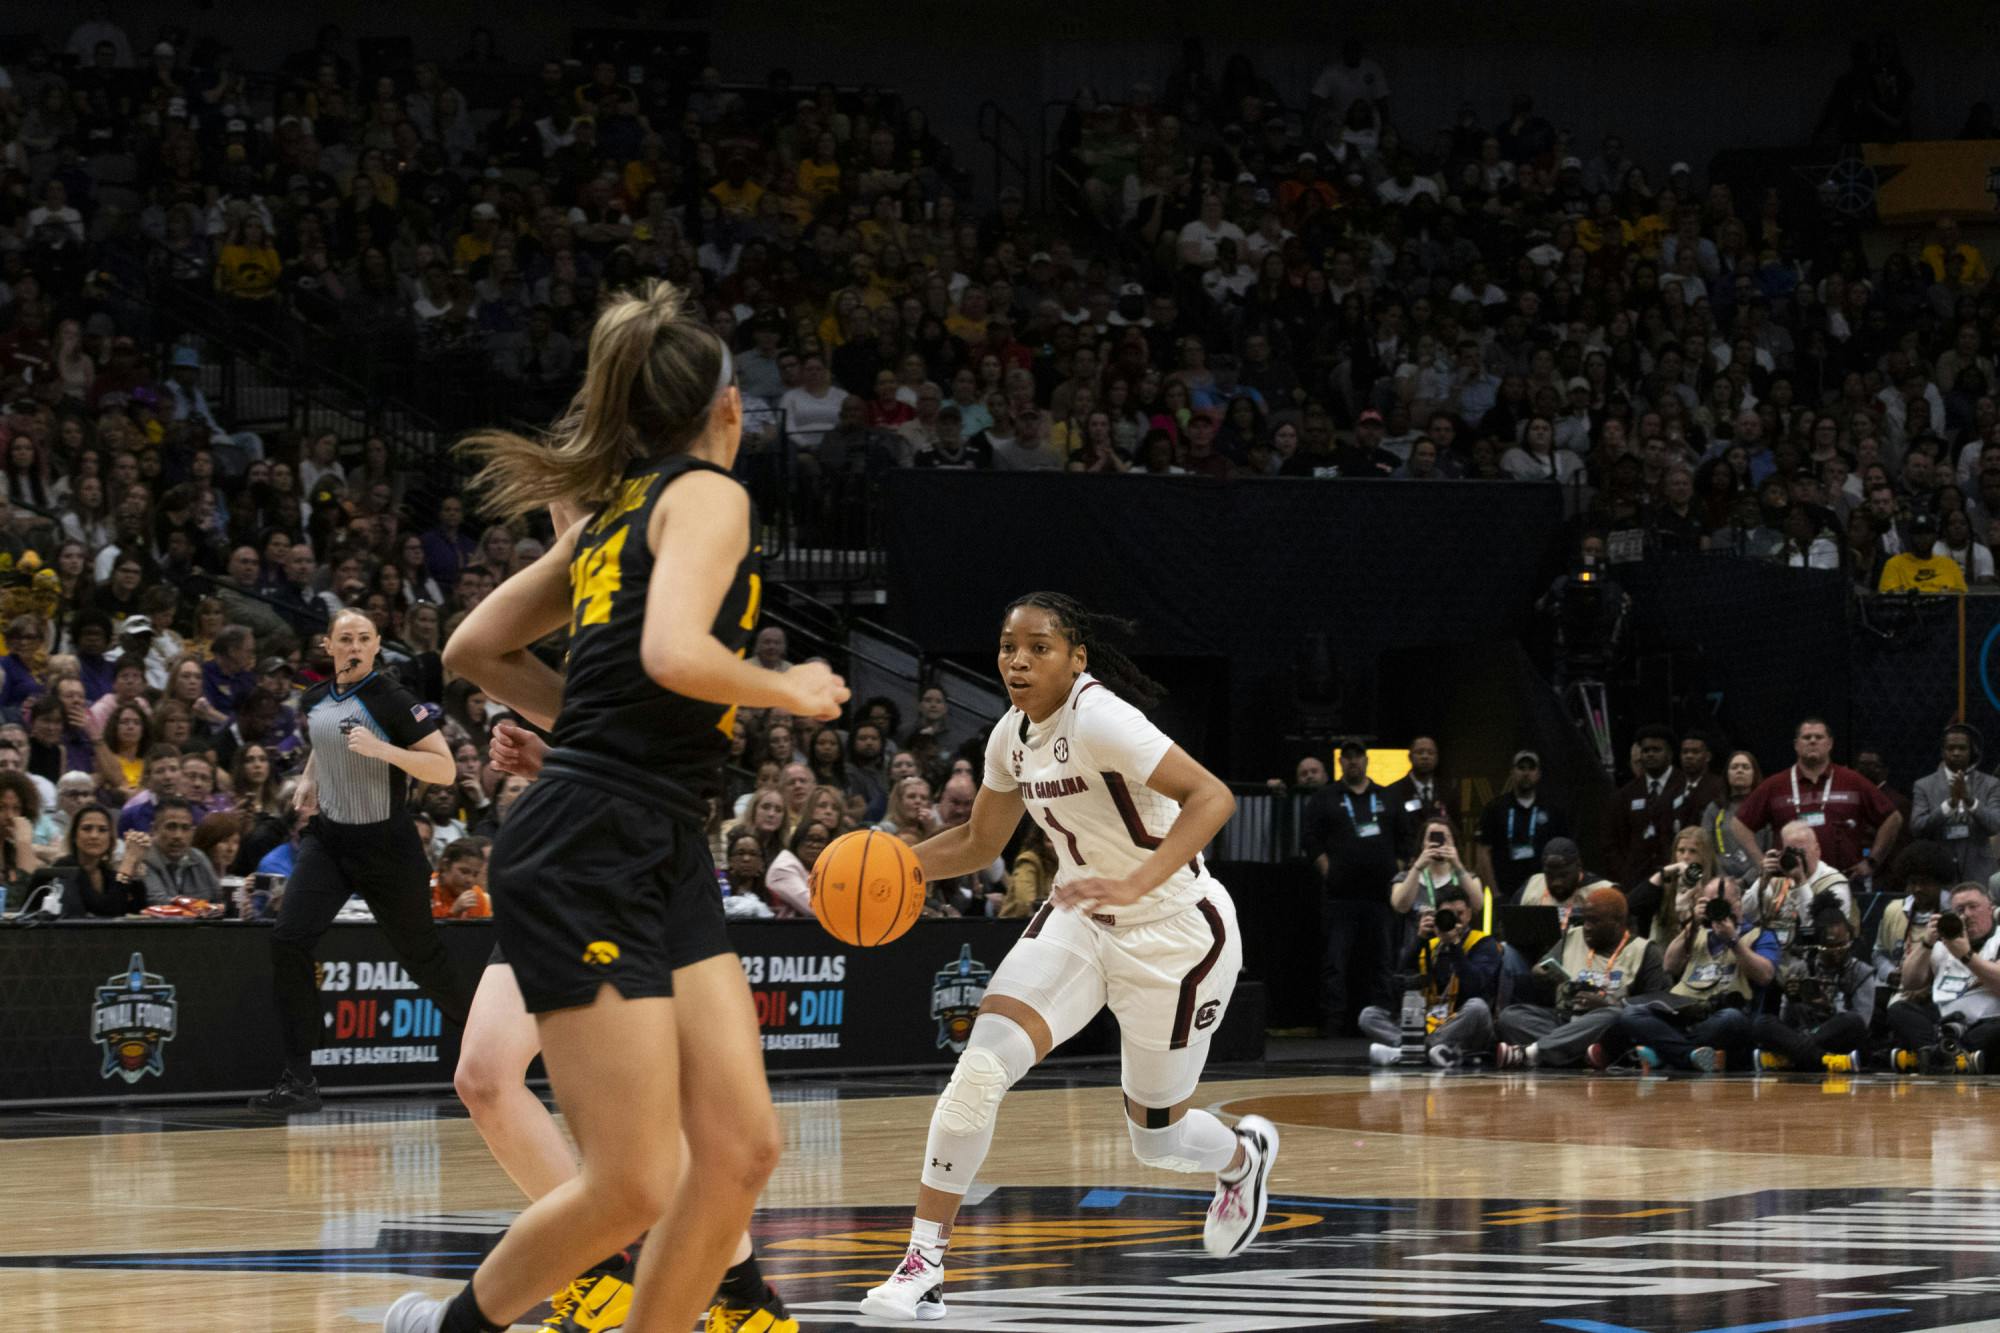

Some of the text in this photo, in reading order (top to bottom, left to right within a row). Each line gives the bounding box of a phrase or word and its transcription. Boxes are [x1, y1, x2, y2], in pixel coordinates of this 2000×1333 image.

[1035, 775, 1089, 799] CAROLINA
[1043, 807, 1087, 866] 1
[355, 961, 420, 991] DALL
[768, 955, 847, 983] DALLAS
[96, 1003, 172, 1032] FINAL FOUR
[335, 998, 443, 1040] DII DIII
[800, 989, 845, 1026] DIII
[353, 1045, 440, 1064] BASKETBALL
[767, 1032, 841, 1050] BASKETBALL
